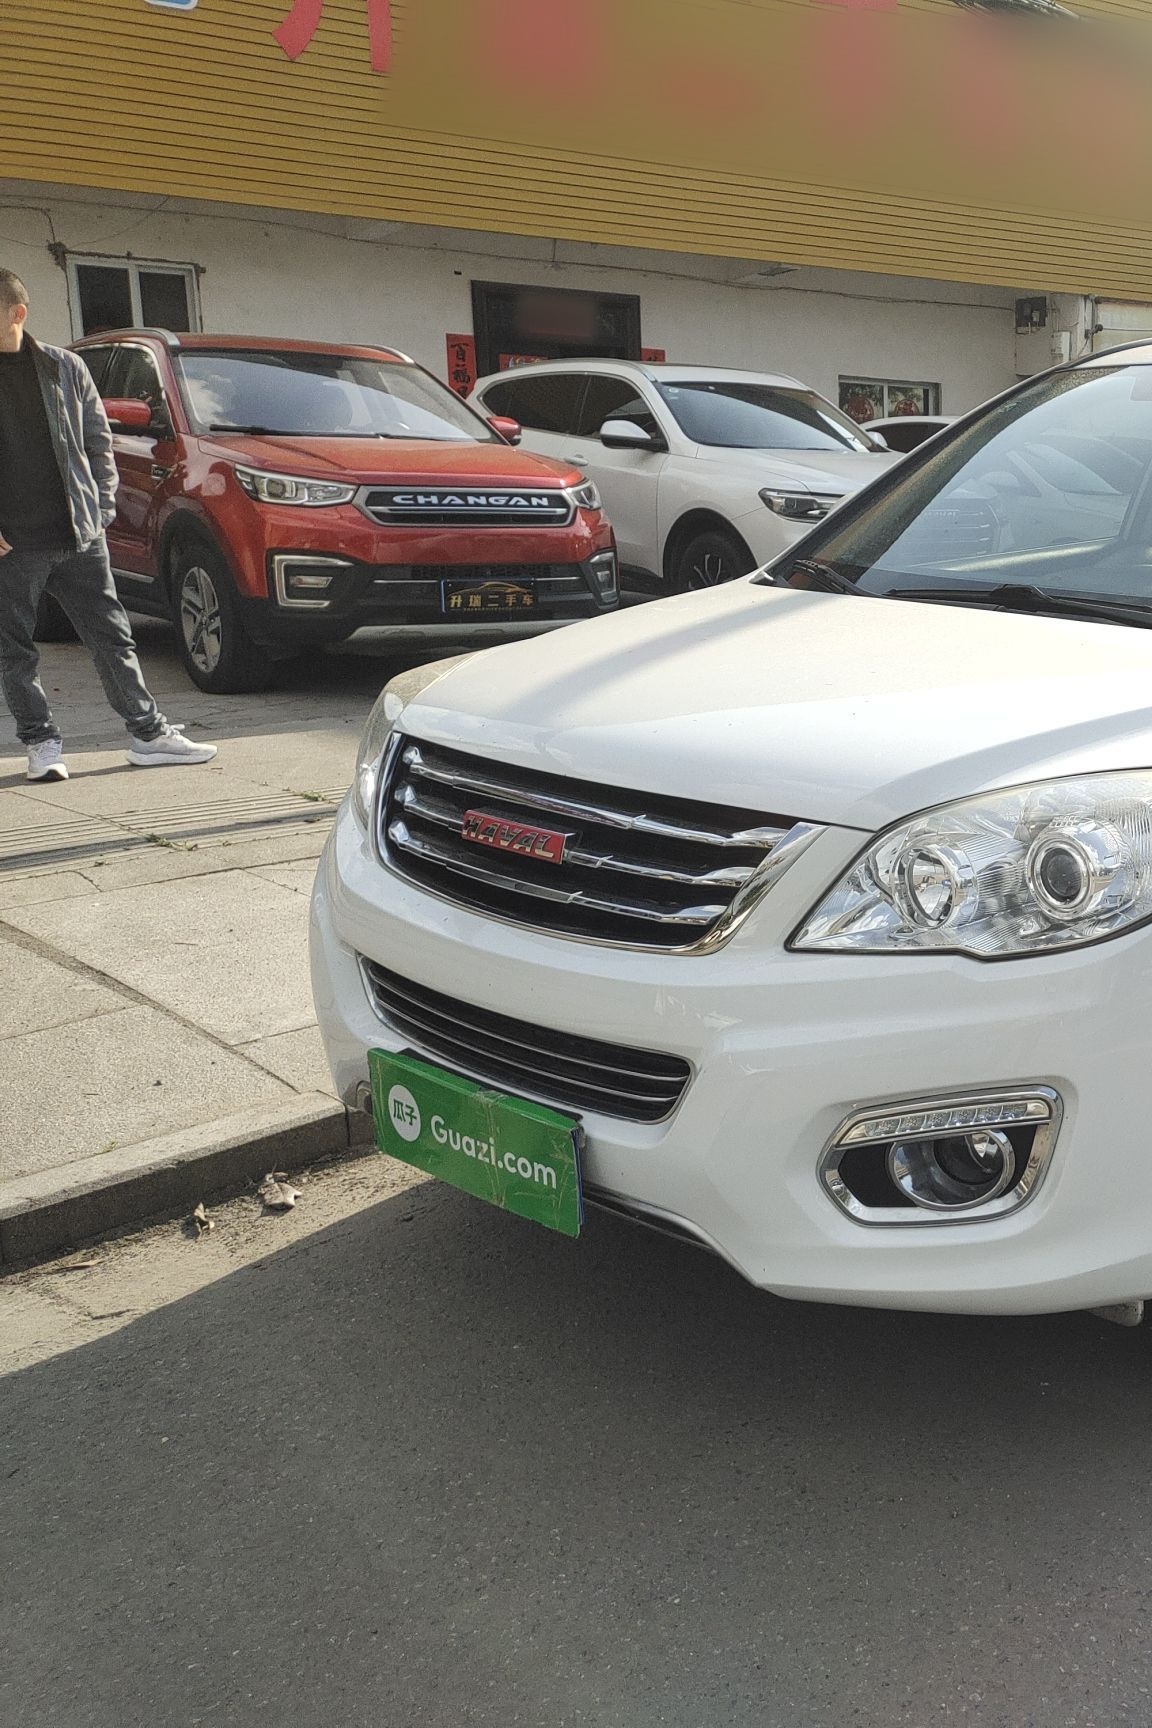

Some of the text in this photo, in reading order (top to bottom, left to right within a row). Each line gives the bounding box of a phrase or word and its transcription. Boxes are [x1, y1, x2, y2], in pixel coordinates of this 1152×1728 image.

[392, 494, 549, 506] CHANGAN
[450, 594, 535, 608] 升瑞二手车
[462, 815, 554, 859] HAVAL
[393, 1099, 418, 1126] 瓜子
[431, 1115, 557, 1190] Guazi.com
